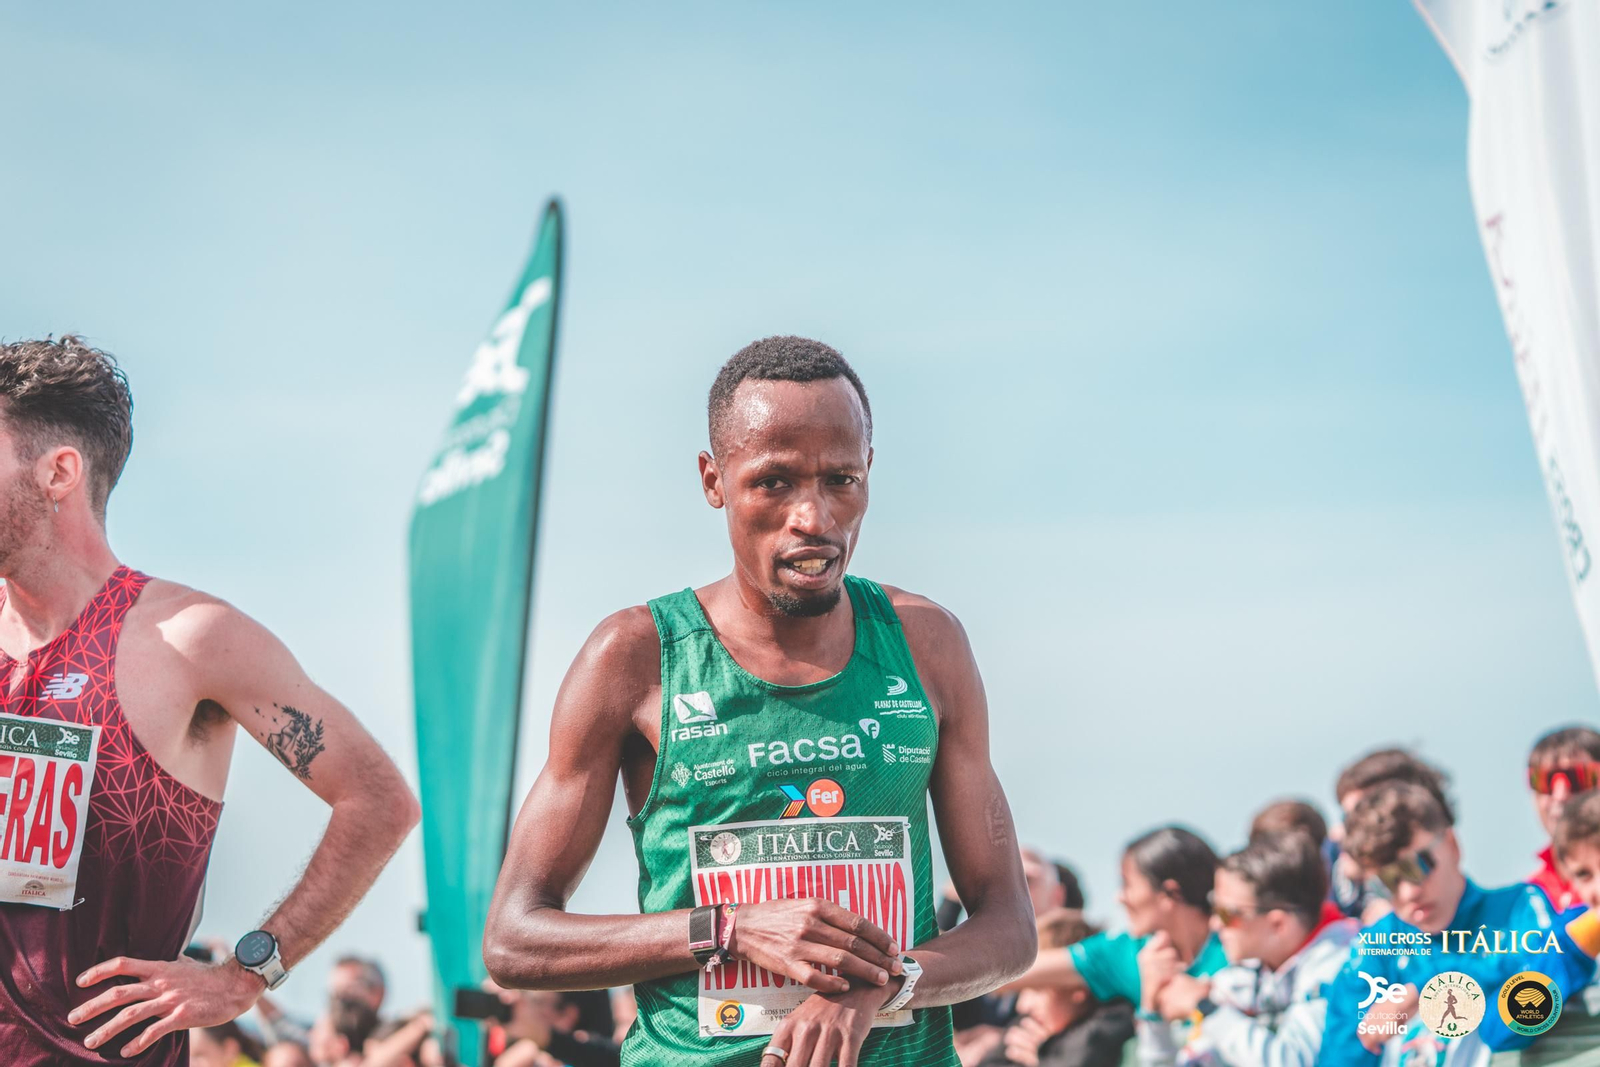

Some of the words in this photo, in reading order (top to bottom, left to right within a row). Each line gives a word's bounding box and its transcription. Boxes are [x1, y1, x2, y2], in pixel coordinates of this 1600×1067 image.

[874, 700, 891, 708] PLAYAS
[892, 700, 898, 708] DE
[748, 734, 865, 767] Facsa
[900, 755, 909, 763] de
[694, 765, 736, 781] Castelló
[791, 765, 825, 775] integral
[828, 764, 842, 772] del
[845, 763, 867, 771] agua
[810, 789, 839, 805] Fer
[757, 827, 861, 855] ITÁLICA
[758, 854, 810, 862] INTERNATIONAL
